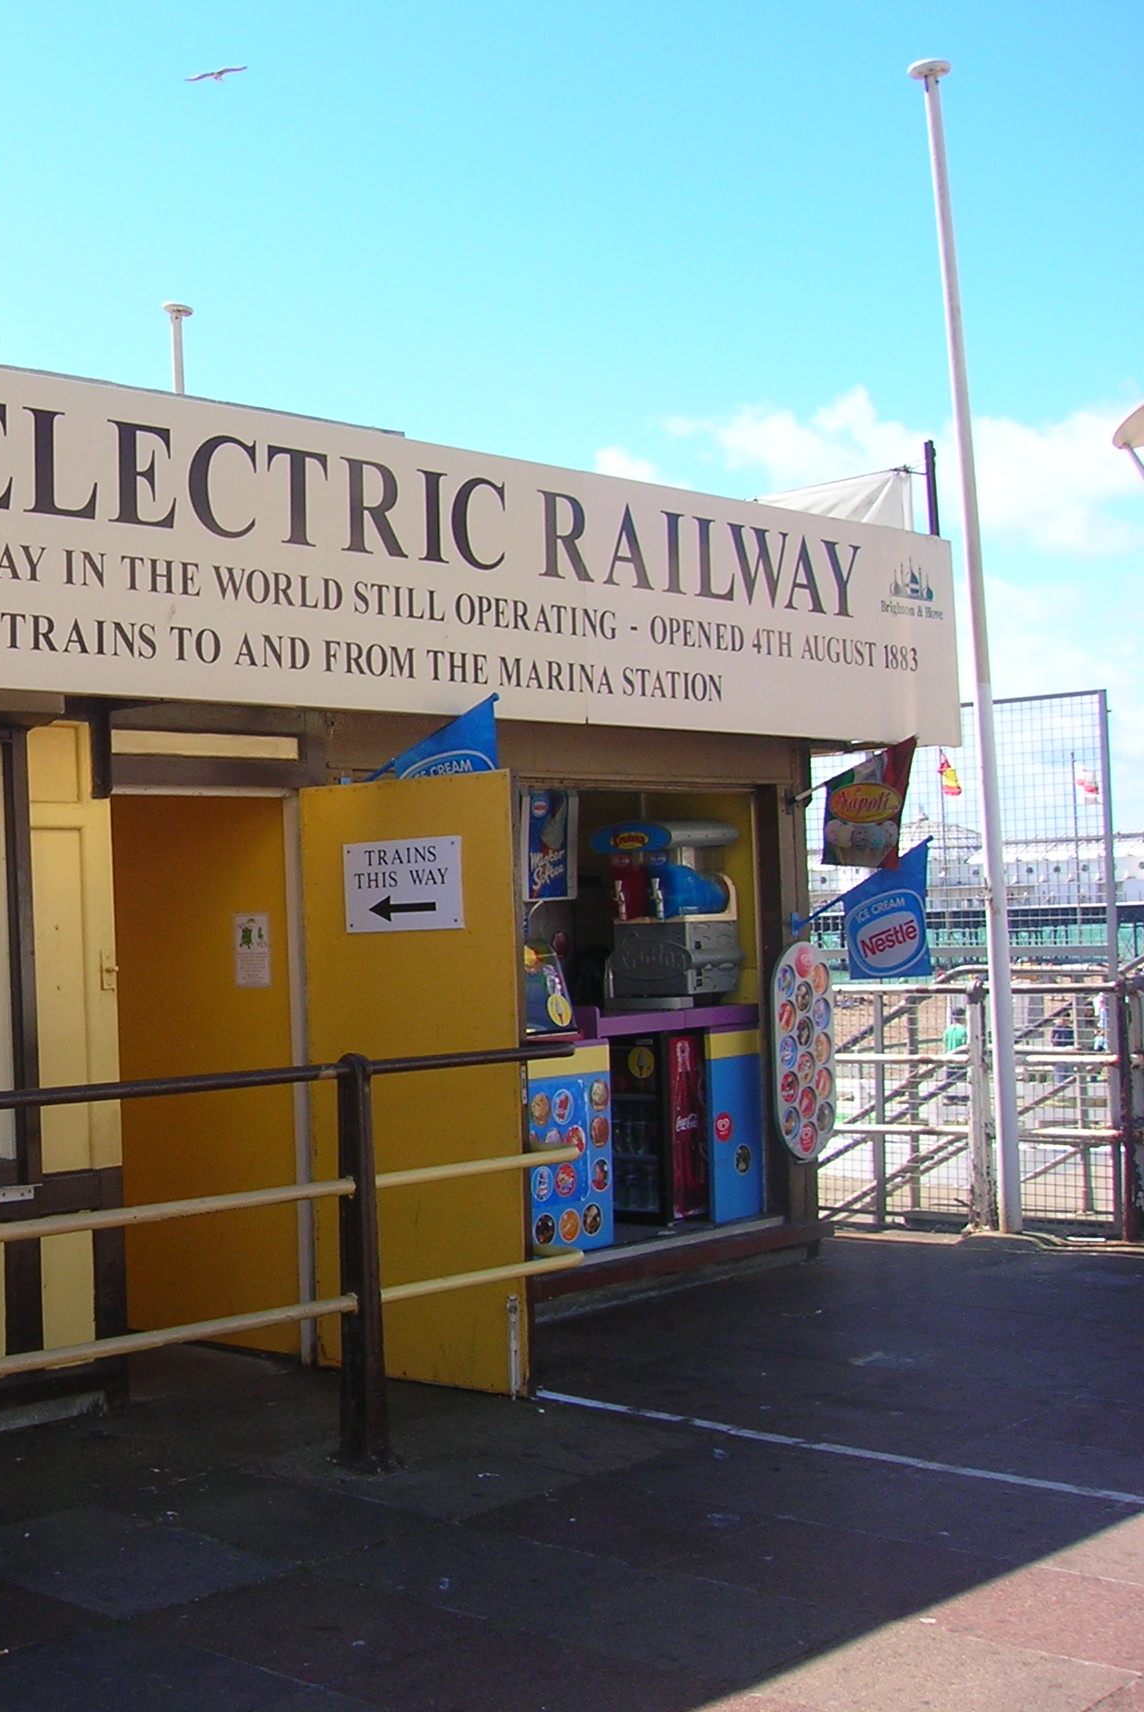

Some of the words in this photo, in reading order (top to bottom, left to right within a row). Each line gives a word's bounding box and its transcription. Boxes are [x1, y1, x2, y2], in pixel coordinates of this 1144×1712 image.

[536, 488, 862, 619] RAILWAY
[63, 548, 107, 588] IN
[120, 555, 202, 597] THE
[212, 565, 343, 611] WORLD
[354, 581, 446, 622] STILL
[455, 592, 617, 641] OPERATING
[650, 614, 745, 653] OPENED
[752, 627, 793, 659] 4TH
[801, 634, 878, 669] AUGUST
[883, 643, 919, 672] 1883
[880, 599, 915, 617] Brighton
[916, 605, 923, 618] &
[924, 606, 944, 621] Hove
[0, 611, 157, 660] TRAINS
[170, 626, 221, 665] TO
[234, 633, 311, 671] AND
[323, 640, 416, 680] FROM
[426, 648, 489, 686] THE
[499, 655, 615, 696] MARINA
[622, 666, 724, 703] STATION
[430, 759, 473, 776] CREAM
[363, 844, 438, 868] TRAINS
[353, 869, 399, 891] THIS
[409, 866, 450, 887] WAY
[854, 908, 871, 924] ICE
[870, 896, 907, 915] CREAM
